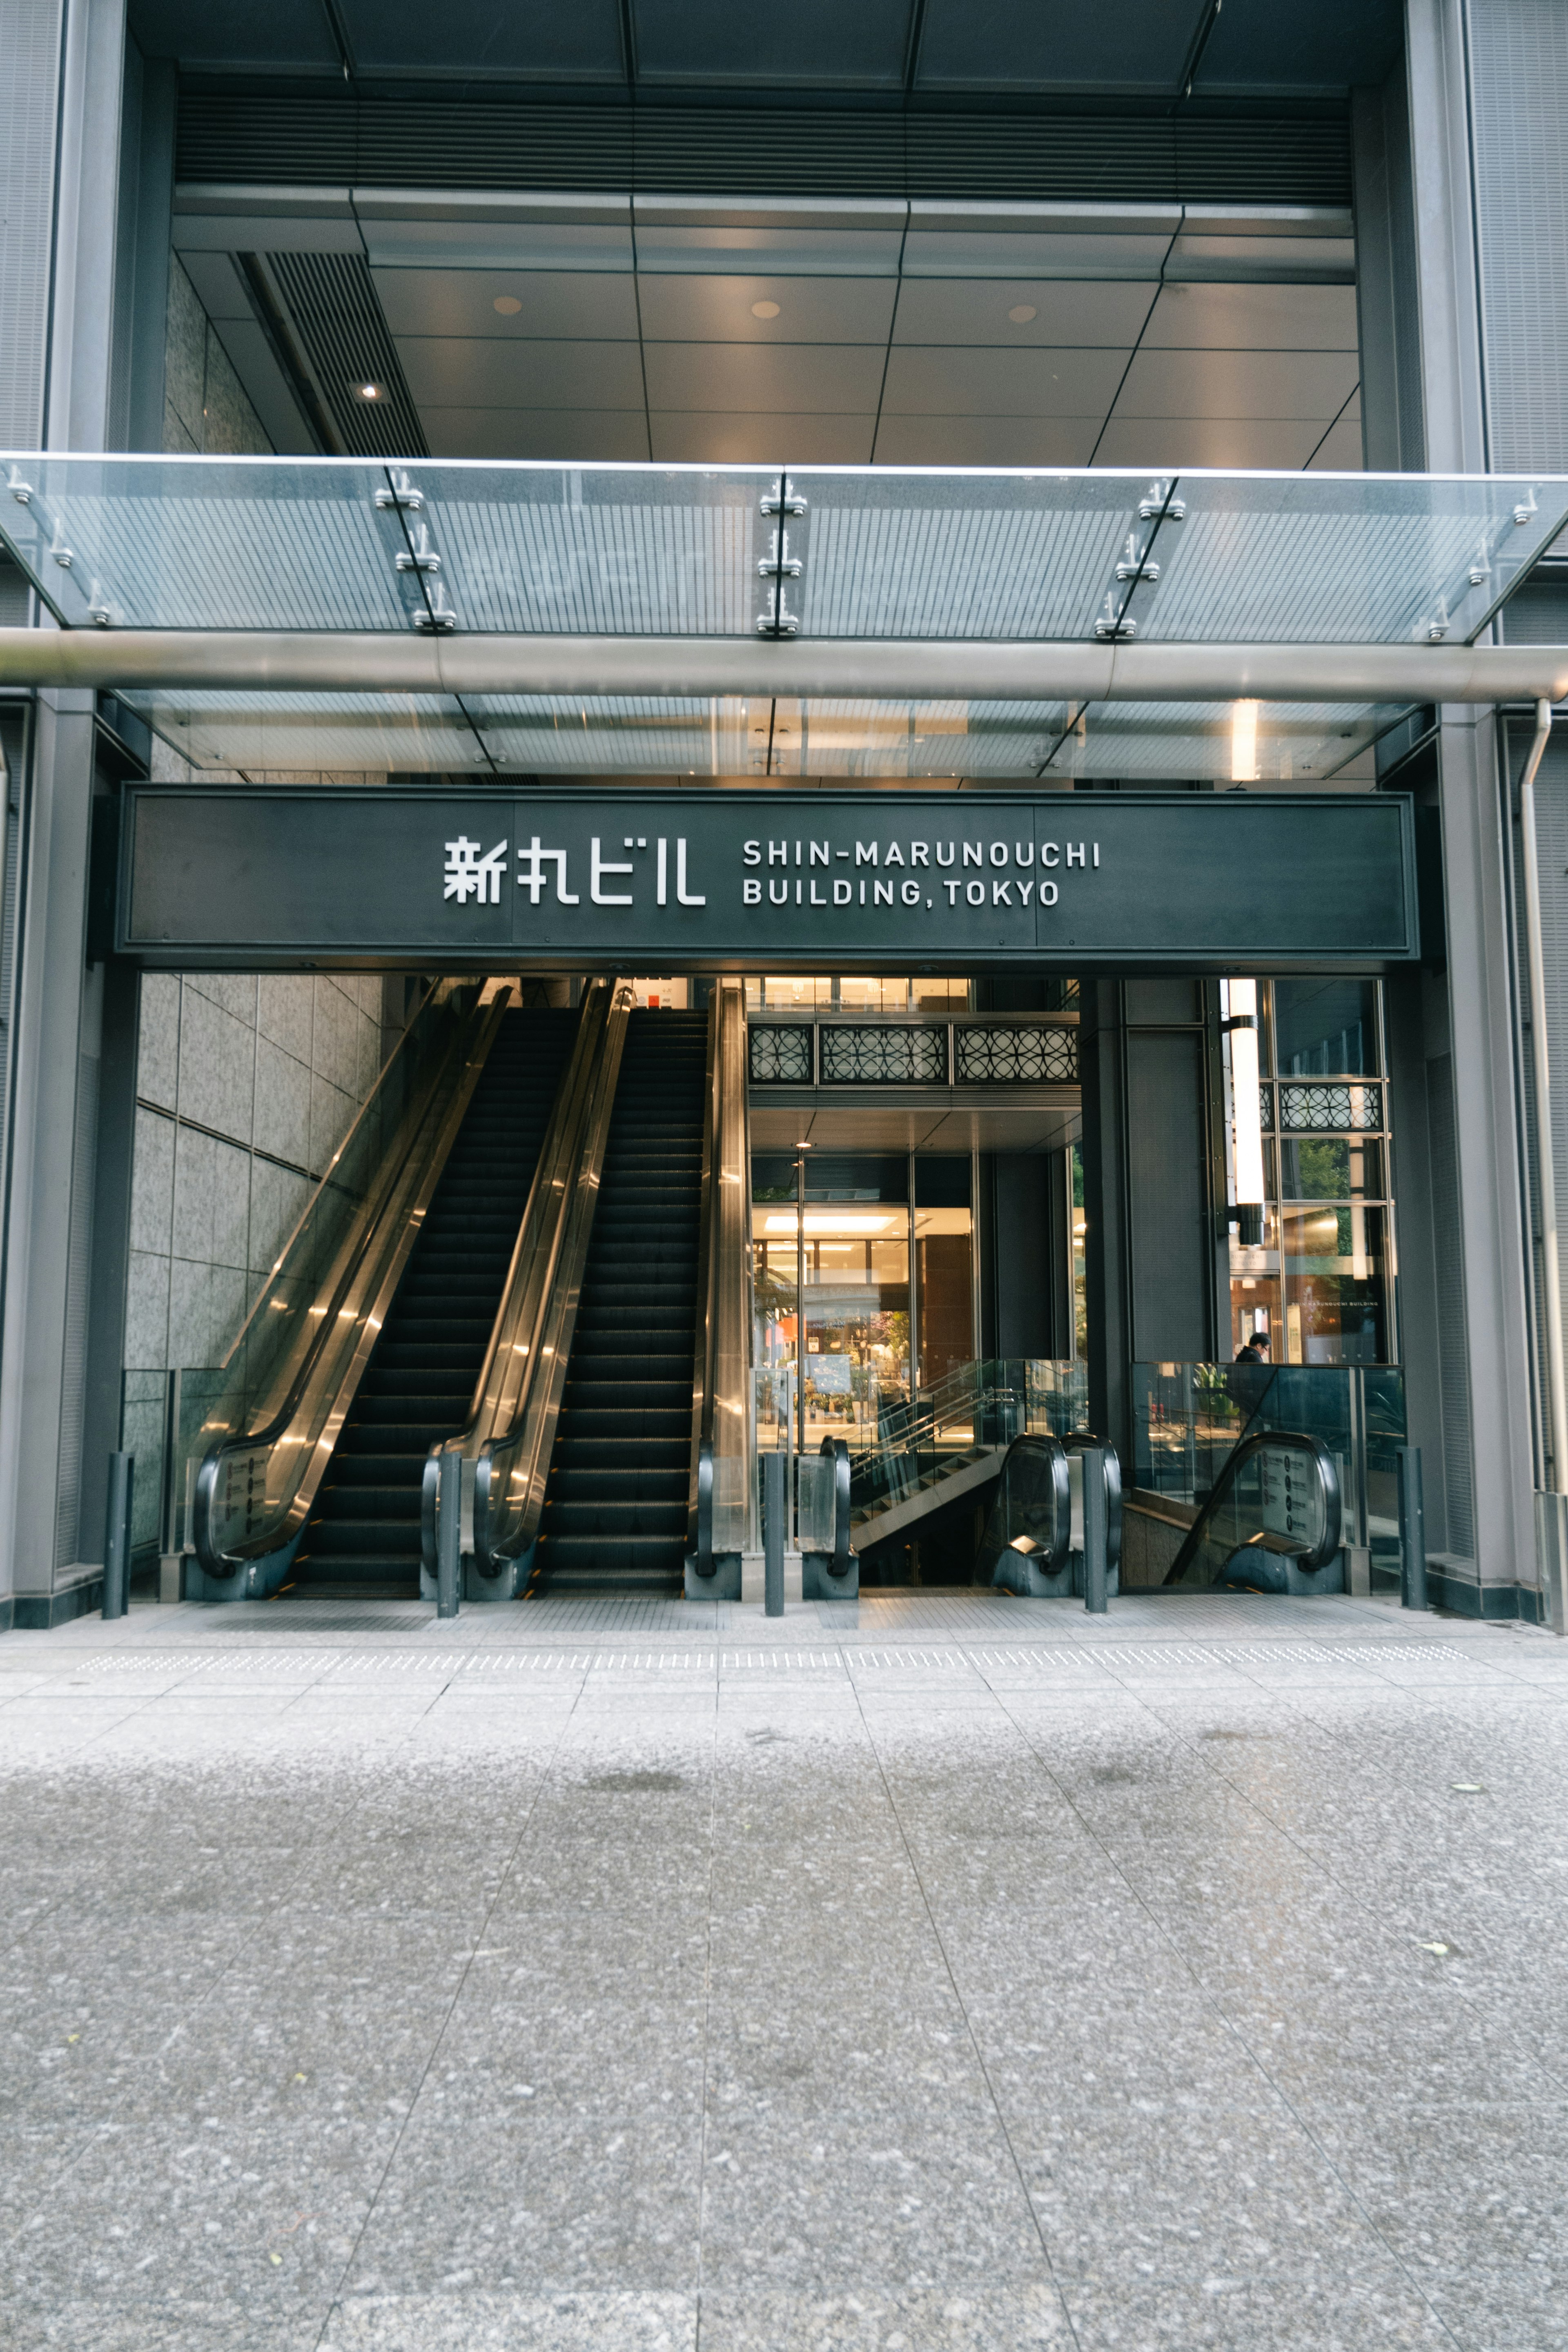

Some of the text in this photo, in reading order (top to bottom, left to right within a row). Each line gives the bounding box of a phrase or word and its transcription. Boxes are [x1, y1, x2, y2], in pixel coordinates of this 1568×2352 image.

[743, 840, 1100, 867] SHIN-MARUNOUCHI
[443, 835, 706, 905] 新丸ビル
[743, 879, 1058, 909] BUILDING, TOKYO
